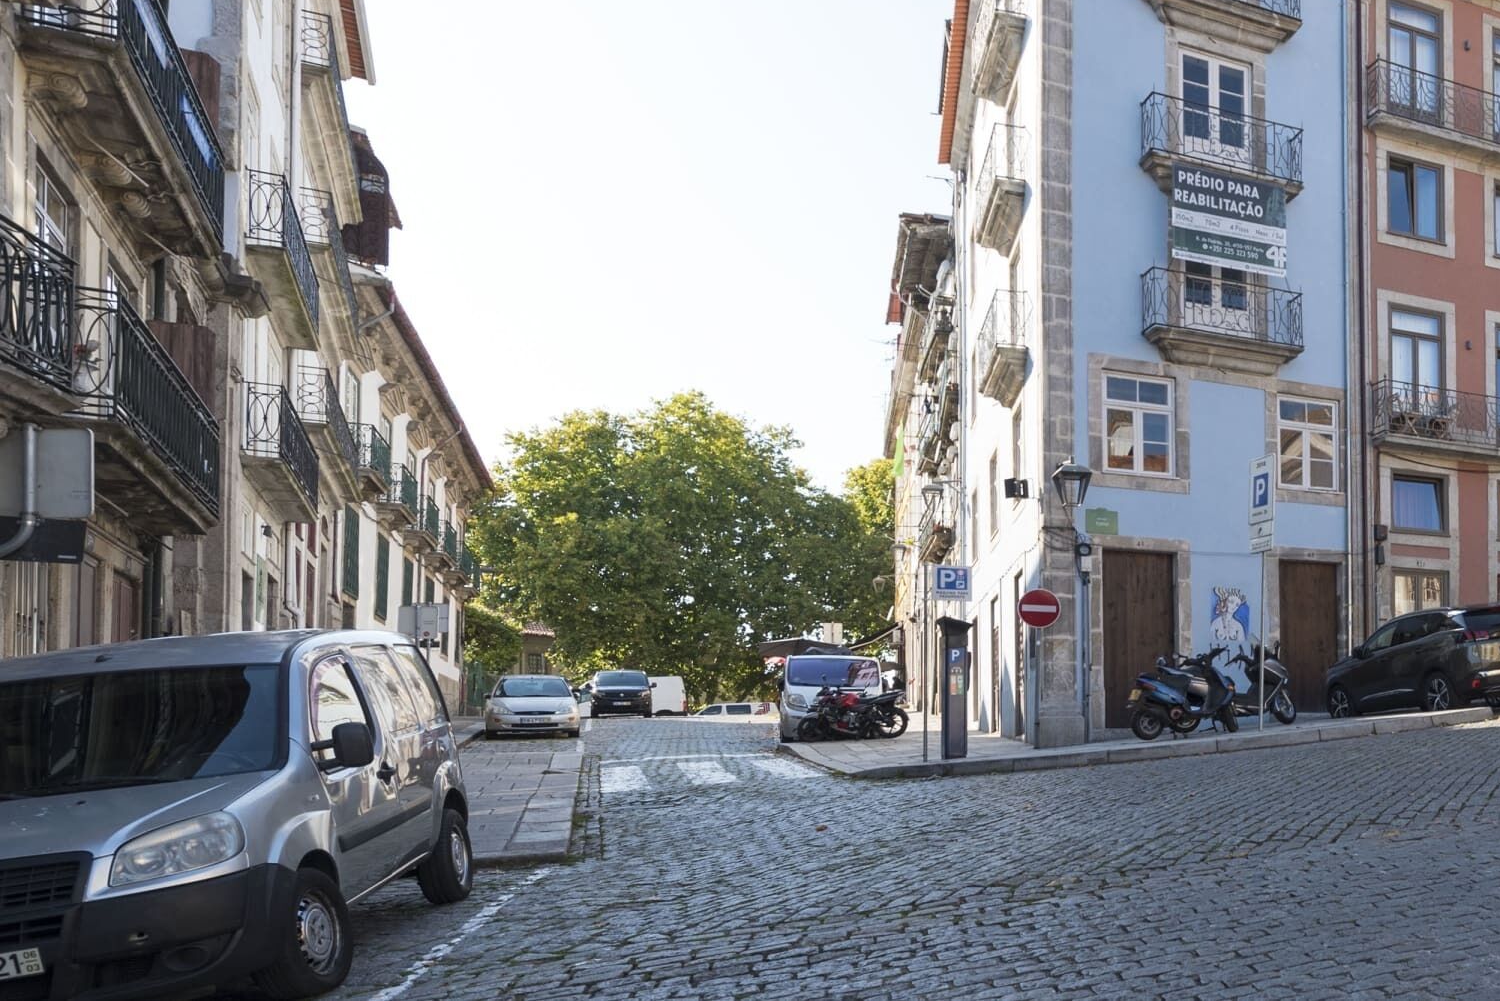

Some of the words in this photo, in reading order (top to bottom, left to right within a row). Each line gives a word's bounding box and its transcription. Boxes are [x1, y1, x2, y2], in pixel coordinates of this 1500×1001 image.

[1178, 170, 1224, 192] PRÉDIO
[1227, 181, 1260, 199] PARA
[1174, 188, 1264, 218] REABILITAÇÃO
[1255, 478, 1266, 505] P
[940, 569, 956, 588] P
[951, 649, 960, 661] P
